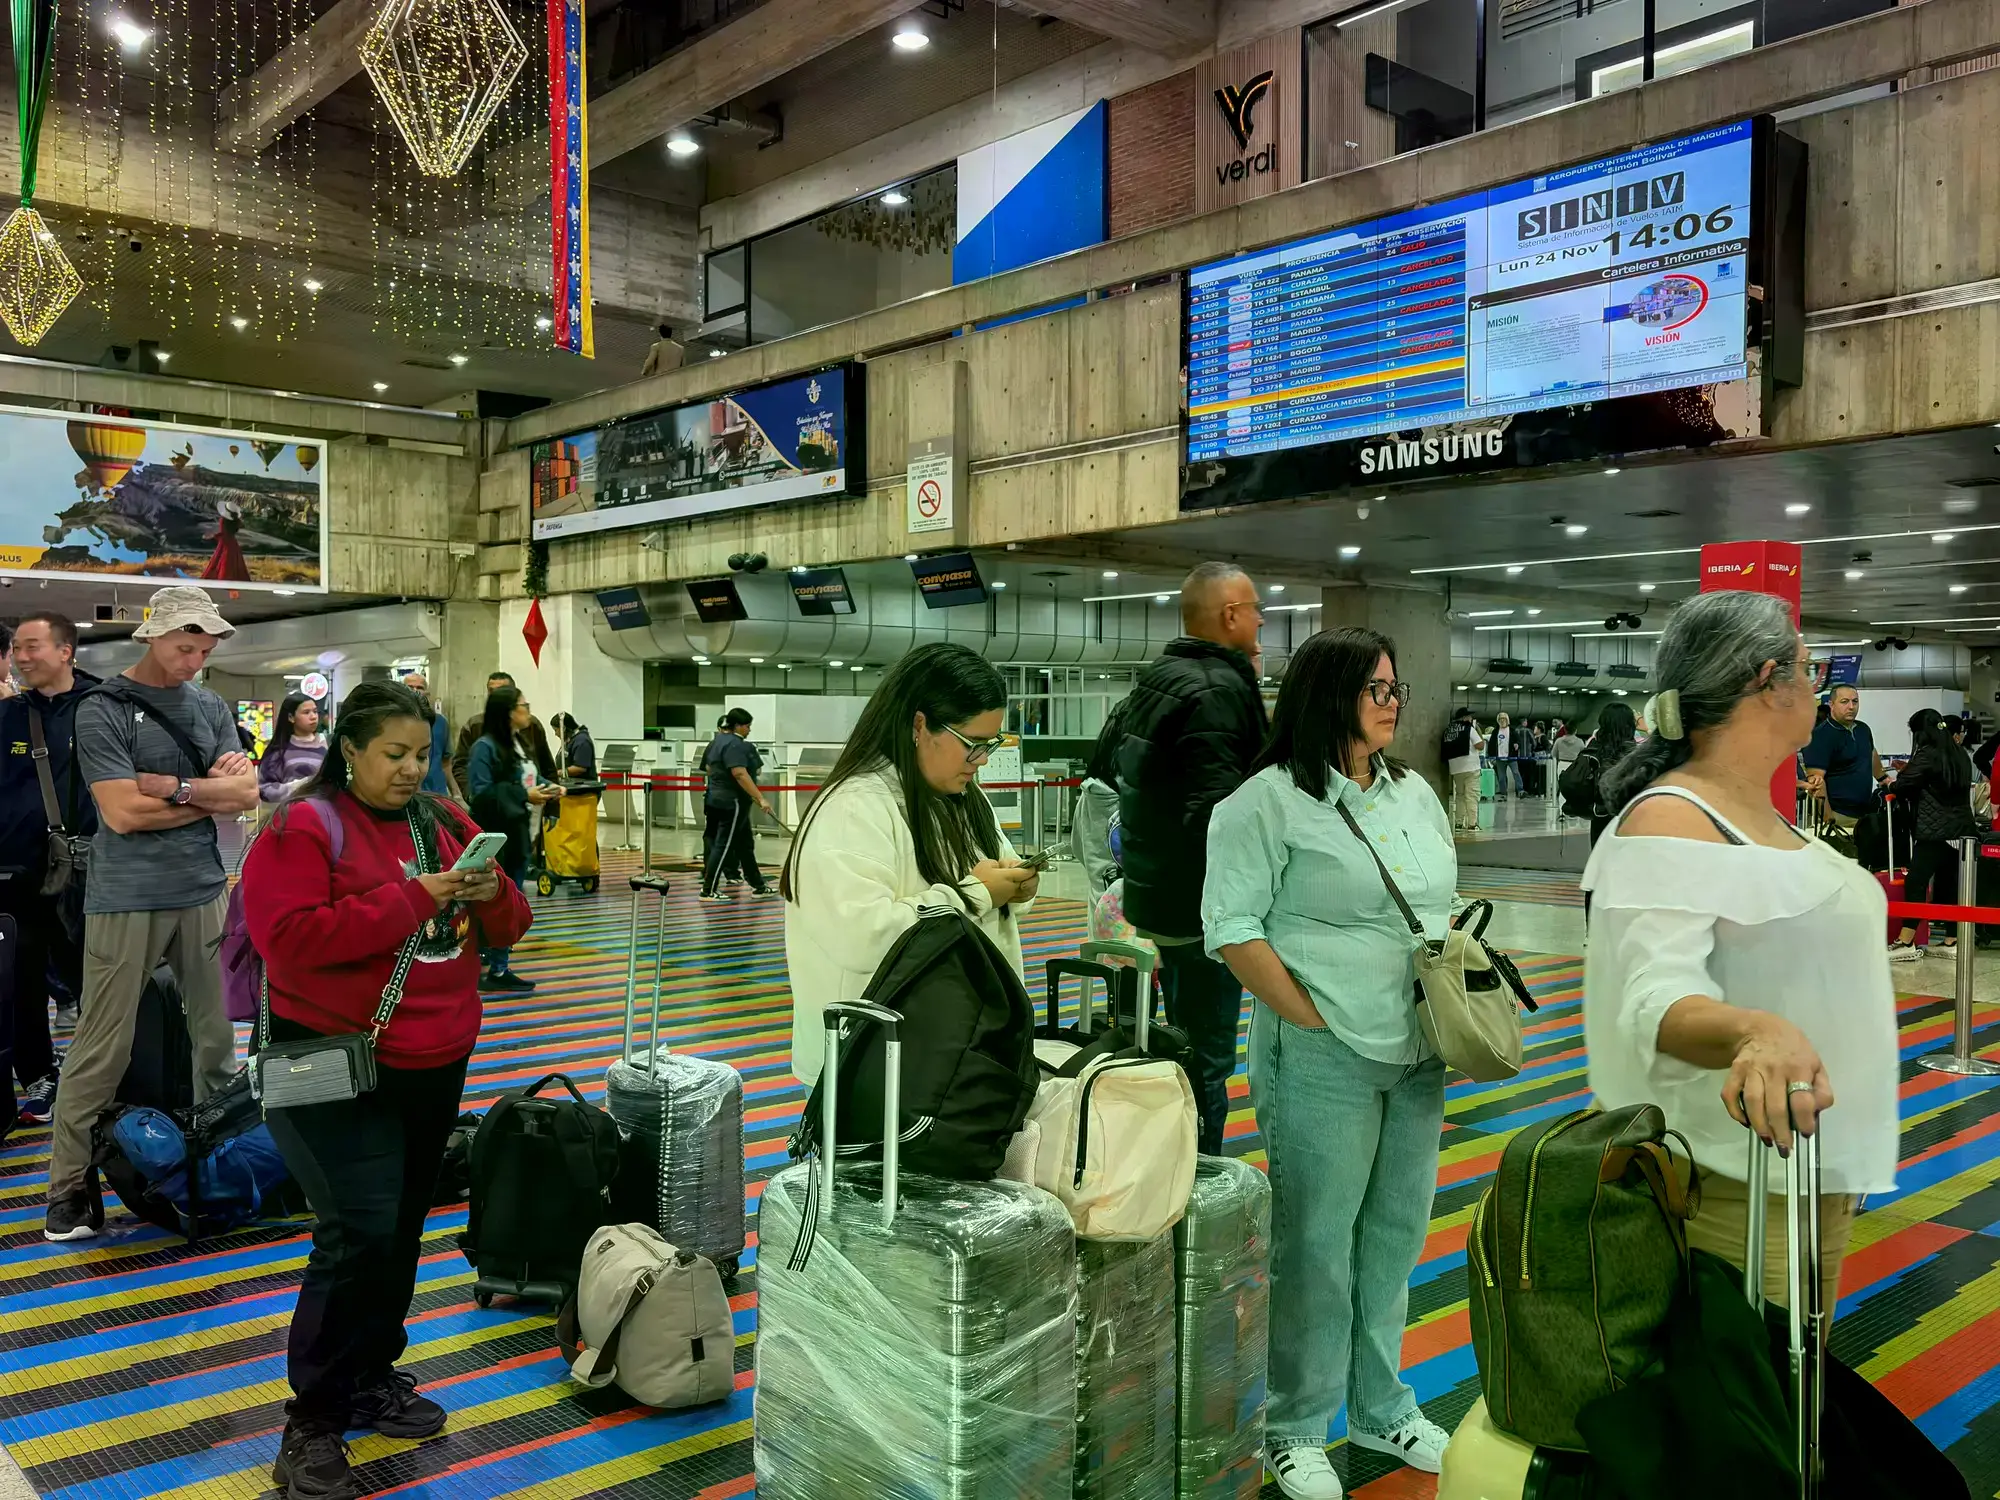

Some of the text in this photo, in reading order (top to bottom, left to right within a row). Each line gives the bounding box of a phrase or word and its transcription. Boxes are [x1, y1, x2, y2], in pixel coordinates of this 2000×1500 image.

[1216, 143, 1276, 185] verdi
[1549, 125, 1743, 182] AEROPUERTO INTERNACIONAL DE MAIQUETÍA
[1522, 174, 1681, 239] SINIV
[1420, 228, 1447, 240] Remark
[1517, 204, 1684, 250] Sistema de Información de Vuelos IAIM
[1602, 204, 1734, 256] 14:06
[1199, 280, 1220, 290] HORA
[1238, 270, 1263, 279] VUELO
[1286, 250, 1340, 268] PROCEDENCIA
[1266, 277, 1280, 285] 222
[1290, 266, 1324, 279] PANAMA
[1386, 248, 1396, 256] 24
[1498, 243, 1600, 274] Lun 24 Nov
[1601, 240, 1742, 278] Cartelera Informativa
[1202, 311, 1219, 319] 14:30
[1290, 284, 1331, 298] ESTAMBUL
[1400, 256, 1454, 272] CANCELADO
[1202, 302, 1219, 310] 14:00
[1290, 276, 1328, 288] CURAZAO
[1290, 306, 1322, 318] BOGOTA
[1400, 277, 1454, 294] CANCELADO
[1302, 294, 1336, 306] HABANA
[1262, 336, 1280, 344] 0192
[1290, 326, 1322, 338] MADRID
[1400, 298, 1454, 314] CANCELADO
[1290, 316, 1324, 328] PANAMA
[1488, 314, 1519, 329] MISIÓN
[1290, 334, 1328, 346] CURAZAO
[1290, 356, 1321, 366] MADRID
[1400, 329, 1454, 344] CANCELADO
[1290, 346, 1322, 356] BOGOTA
[1644, 332, 1680, 346] VISIÓN
[1290, 366, 1321, 376] MADRID
[1400, 340, 1453, 354] CANCELADO
[1290, 376, 1322, 386] CANCUN
[1281, 434, 1326, 446] usuarios
[1328, 430, 1348, 440] que
[1384, 420, 1409, 430] sitio
[1412, 412, 1446, 426] 100%
[1448, 408, 1476, 420] libre
[1480, 405, 1496, 414] de
[1500, 400, 1535, 411] humo
[1558, 389, 1605, 403] tabaco
[1622, 382, 1646, 394] The
[1650, 372, 1707, 388] airport
[1290, 394, 1328, 406] CURAZAO
[1290, 406, 1314, 415] SANTA
[1316, 400, 1340, 411] LUCIA
[1341, 396, 1372, 406] MEXICO
[1290, 414, 1327, 425] CURAZAO
[1290, 425, 1322, 434] PANAMA
[1202, 450, 1220, 459] IAIM
[1360, 429, 1503, 474] SAMSUNG
[1708, 564, 1741, 573] IBERIA
[1768, 563, 1790, 572] IBERIA
